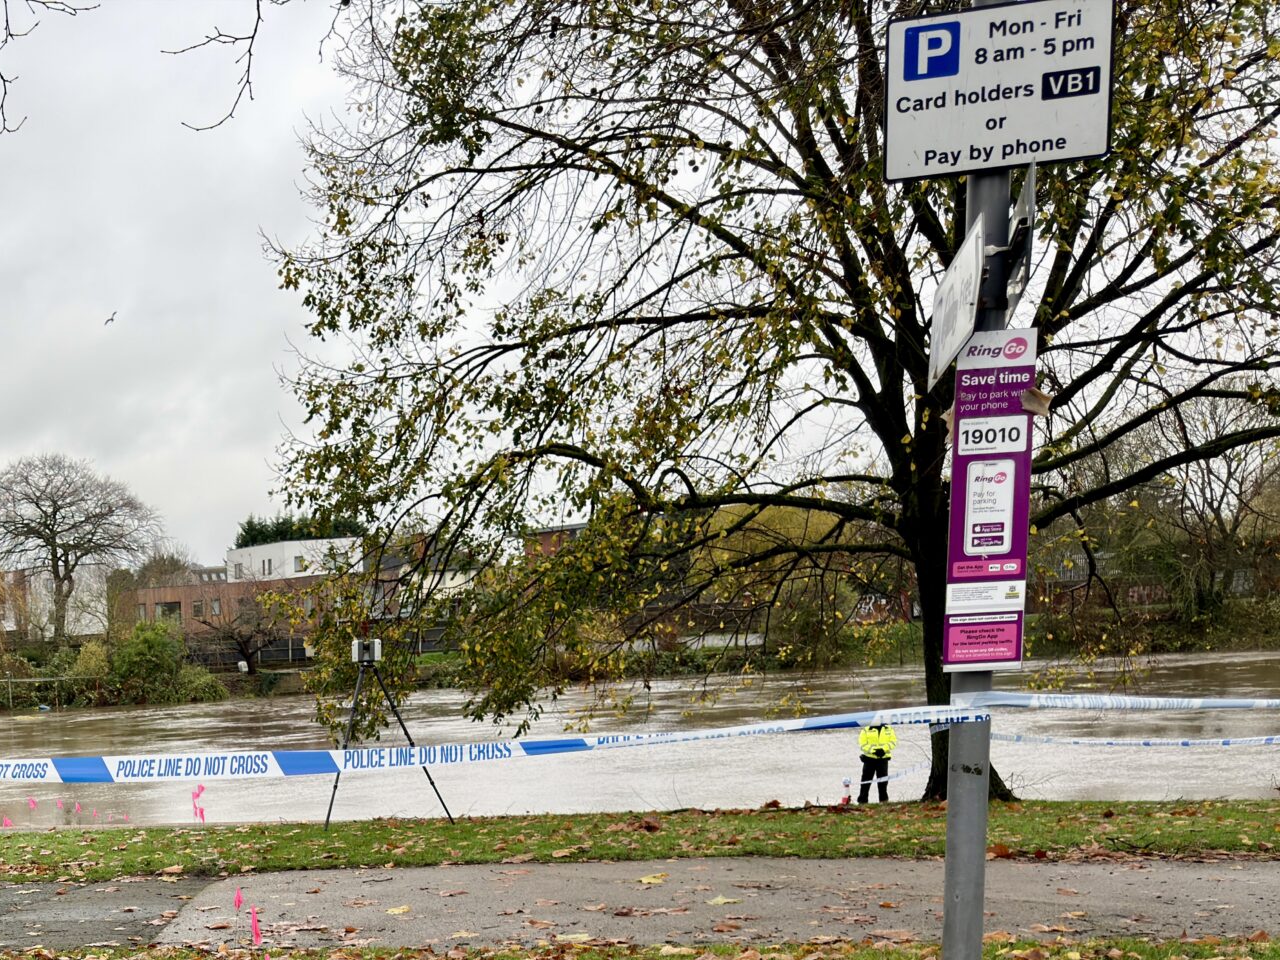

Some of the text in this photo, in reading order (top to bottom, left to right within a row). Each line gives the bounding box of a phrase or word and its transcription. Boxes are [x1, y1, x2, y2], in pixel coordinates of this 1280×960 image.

[989, 20, 1034, 38] Mon
[1055, 9, 1082, 29] Fri
[917, 29, 952, 75] P
[974, 48, 987, 65] 8
[993, 46, 1024, 62] am
[1044, 38, 1056, 55] 5
[1062, 37, 1095, 57] pm
[896, 71, 1095, 113] Card holders VB1
[985, 116, 1007, 131] or
[924, 137, 1067, 167] Pay by phone
[966, 342, 1026, 358] RingGo
[961, 371, 1031, 386] Save time
[960, 388, 1026, 402] Pay to park wit
[960, 401, 1009, 413] your phone
[961, 426, 1021, 445] 19010
[116, 754, 268, 778] POLICE LINE DO NOT CROSS
[343, 741, 512, 770] POLICE LINE DO NOT CROSS
[11, 762, 48, 779] CROSS
